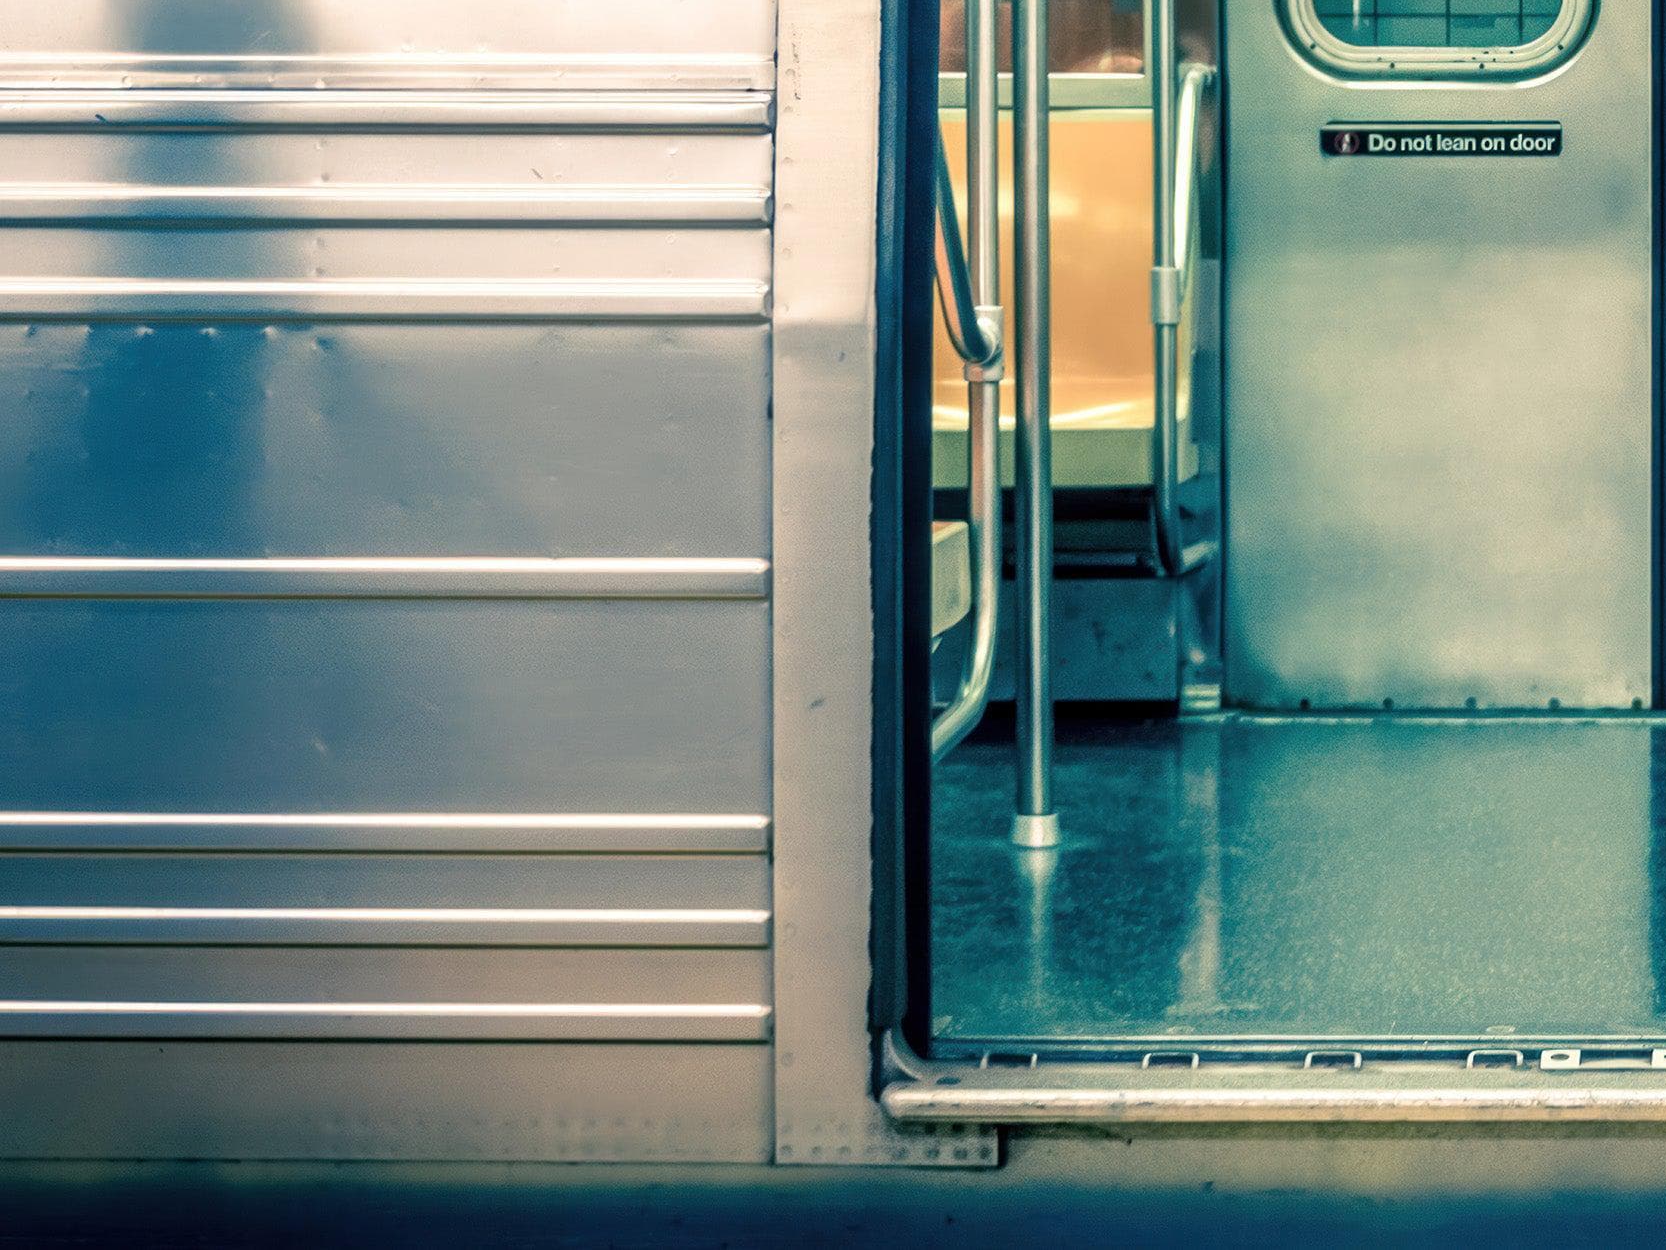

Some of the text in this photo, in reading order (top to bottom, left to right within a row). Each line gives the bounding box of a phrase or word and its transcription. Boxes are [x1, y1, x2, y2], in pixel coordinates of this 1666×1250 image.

[1367, 133, 1556, 152] Do not lean on door
